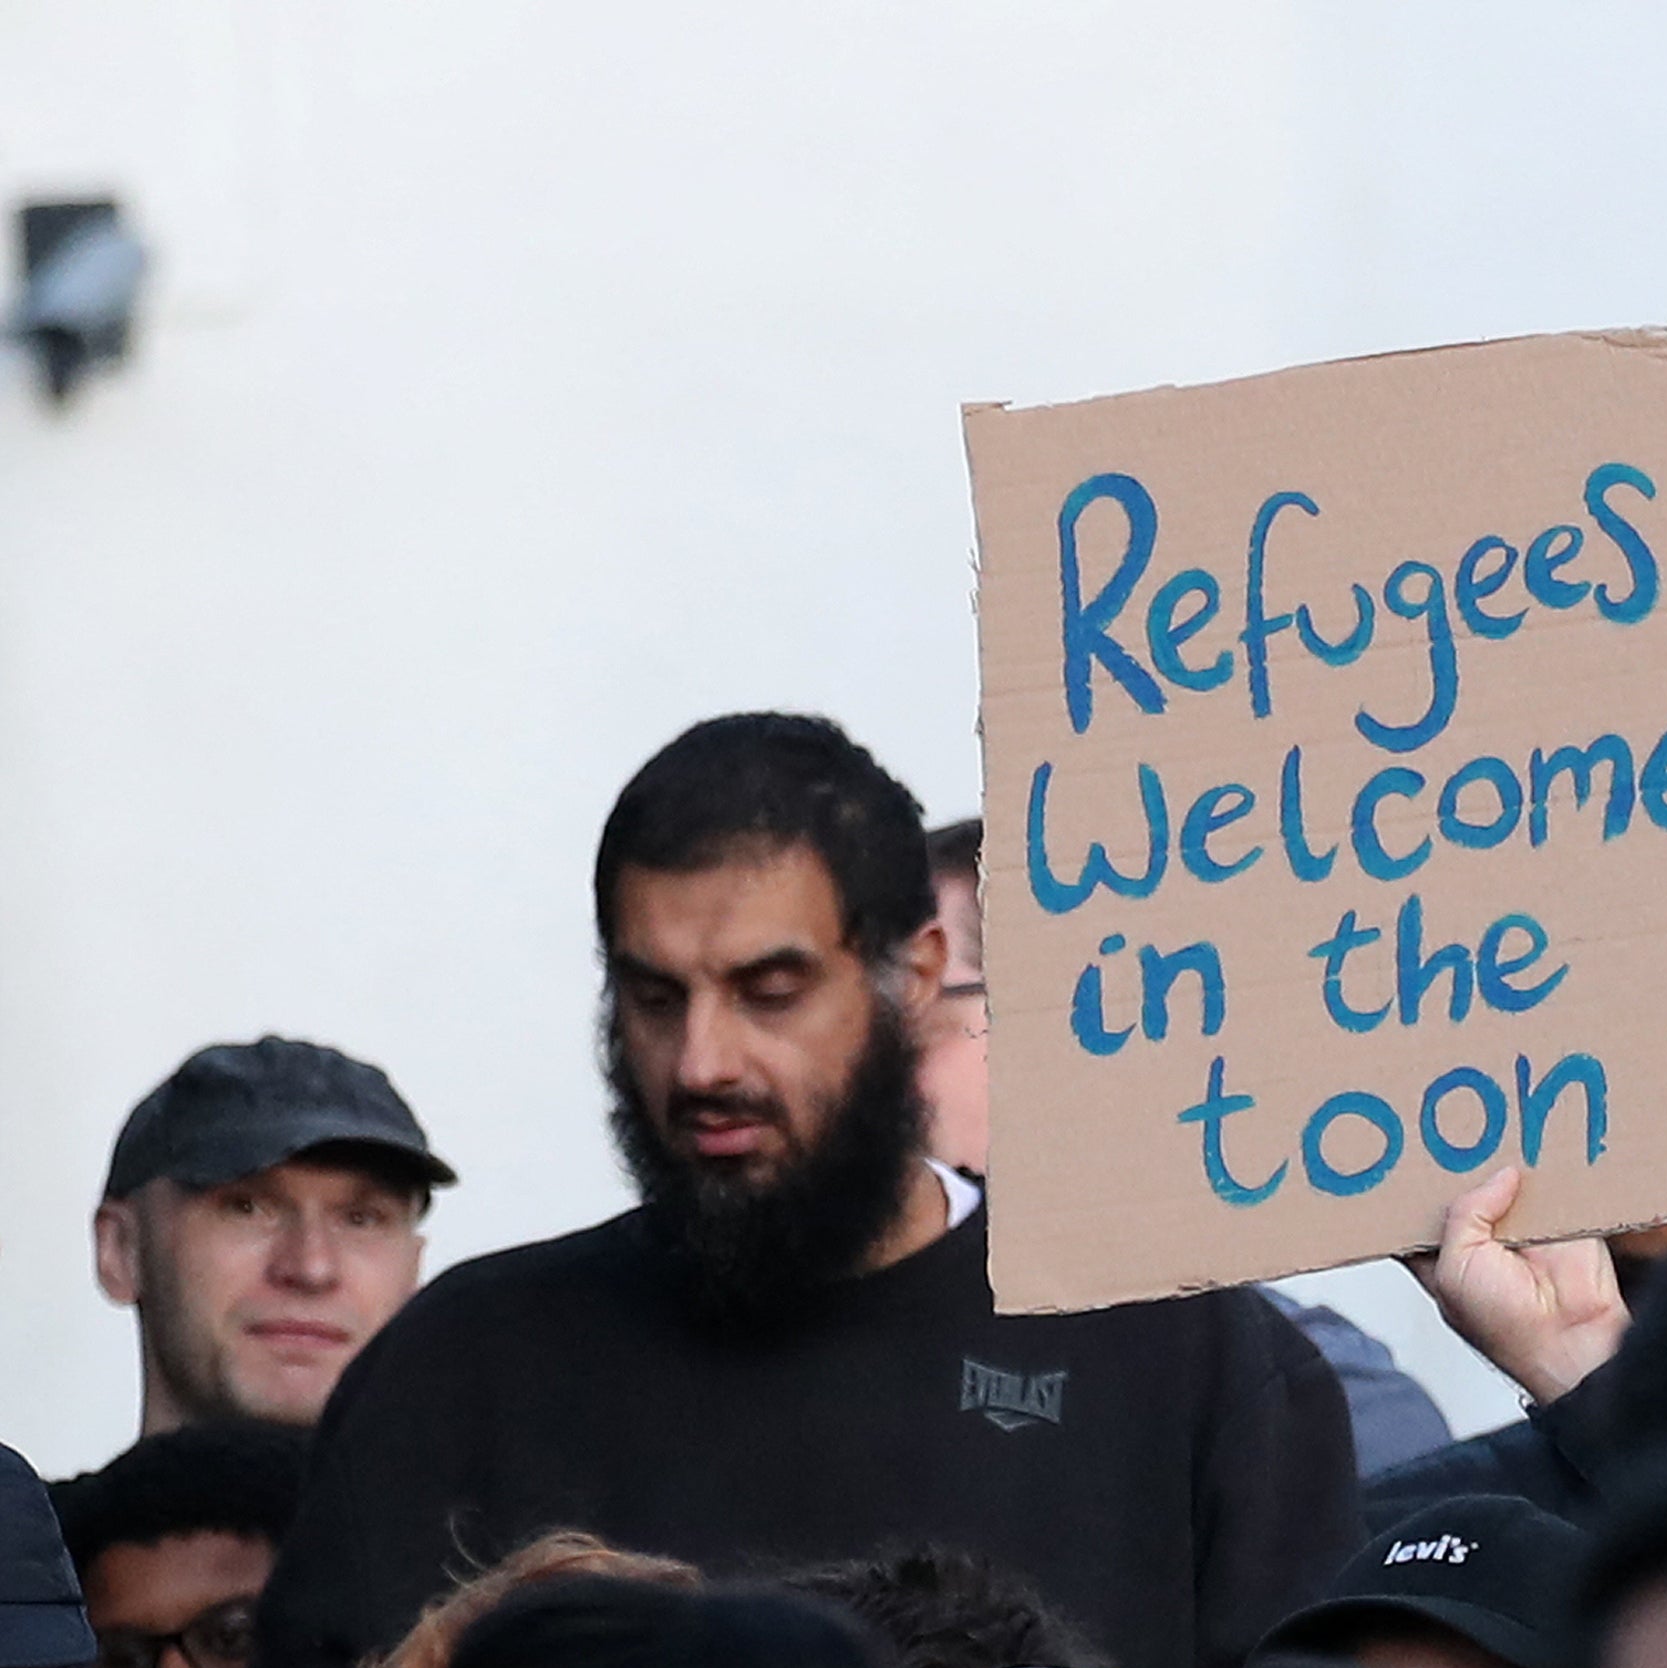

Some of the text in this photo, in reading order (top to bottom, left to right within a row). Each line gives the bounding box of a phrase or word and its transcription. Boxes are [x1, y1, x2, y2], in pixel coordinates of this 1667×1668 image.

[1071, 895, 1571, 1057] in the
[1178, 1052, 1609, 1206] toon
